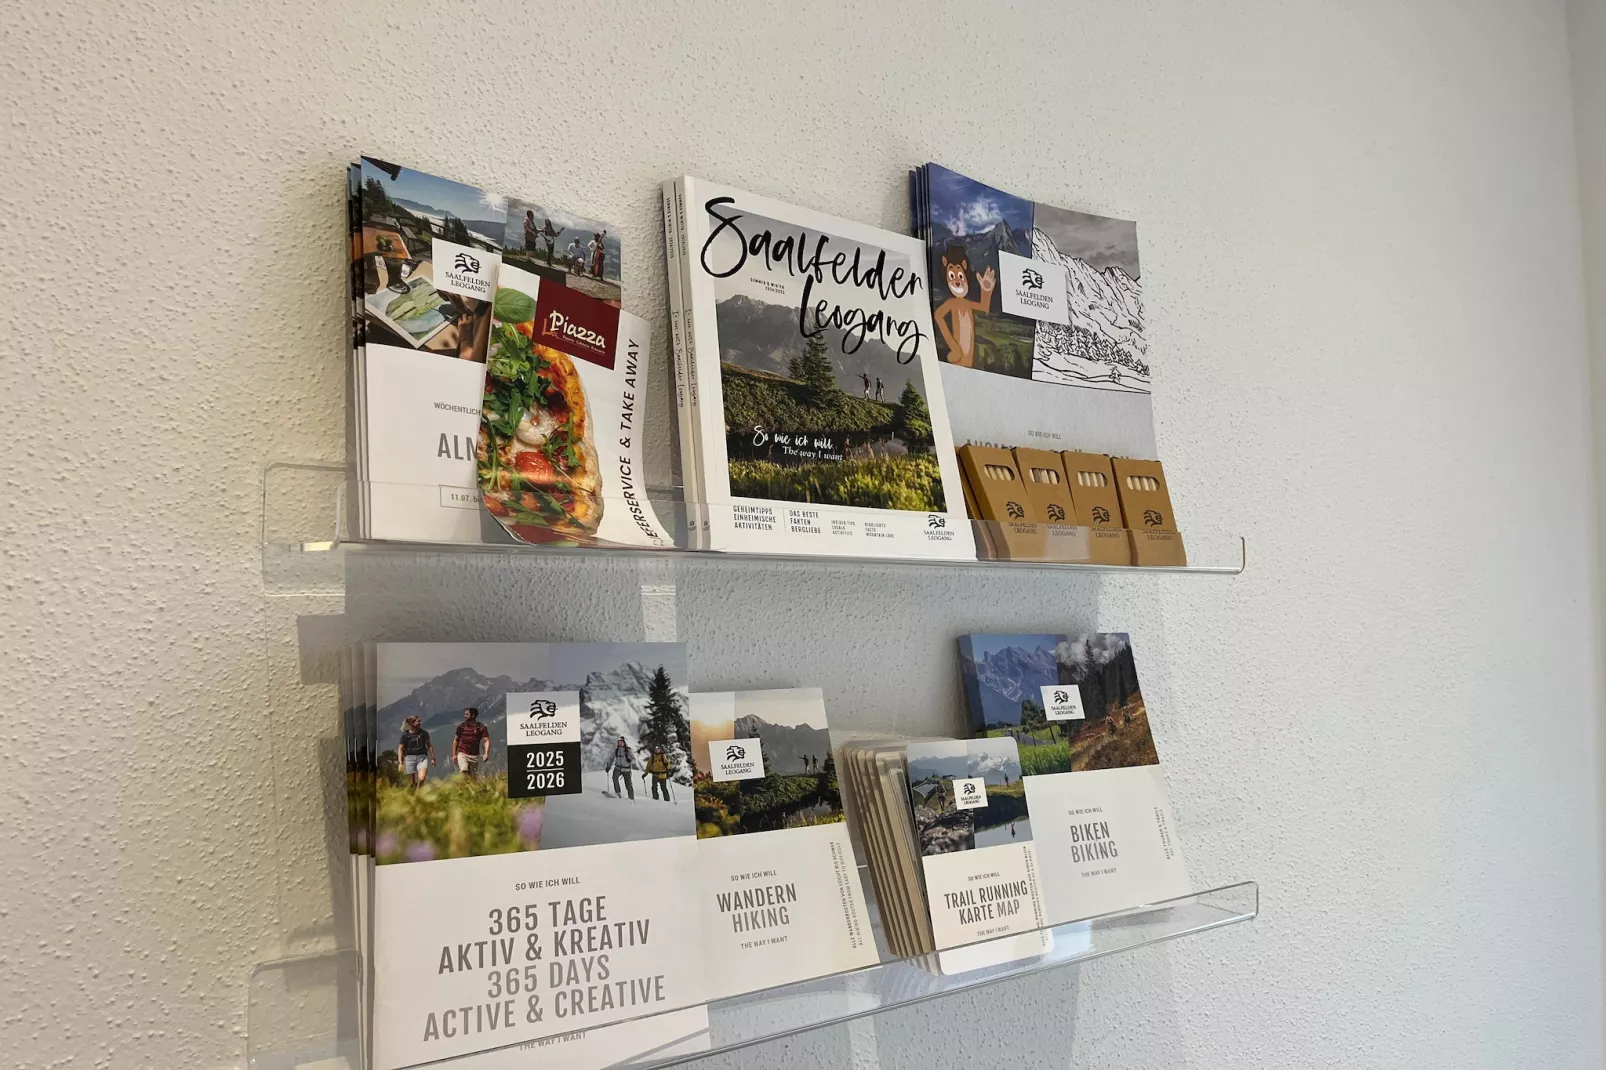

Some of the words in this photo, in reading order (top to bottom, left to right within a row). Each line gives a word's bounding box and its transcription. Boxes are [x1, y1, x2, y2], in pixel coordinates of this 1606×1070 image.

[700, 196, 924, 301] Saalfelden
[445, 271, 491, 288] SAALFELDEN
[450, 280, 486, 294] LEOGANG
[1015, 288, 1054, 303] SAALFELDEN
[1020, 296, 1050, 310] LEOGANG
[800, 274, 930, 366] Leogang
[550, 310, 606, 348] Piazza
[626, 338, 639, 389] AWAY
[620, 391, 635, 430] TAKE
[619, 435, 632, 448] &
[753, 426, 769, 446] So
[774, 433, 790, 445] wie
[795, 434, 809, 447] ich
[814, 438, 834, 450] will
[783, 446, 798, 456] The
[800, 450, 816, 460] way
[824, 452, 843, 461] want
[732, 505, 773, 515] GEHEIMTIPPS
[734, 513, 776, 523] EINHEIMISCHE
[734, 521, 772, 531] AKTIVITÄTEN
[791, 525, 821, 534] BERGLIEBE
[520, 721, 568, 730] SAALFELDEN
[526, 728, 563, 737] LEOGANG
[526, 751, 564, 768] 2025
[726, 767, 752, 775] LEOGANG
[526, 772, 565, 790] 2026
[1070, 821, 1110, 842] BIKEN
[1071, 840, 1118, 863] BIKING
[529, 881, 543, 889] WIE
[546, 879, 559, 887] ICH
[561, 877, 580, 886] WILL
[717, 883, 797, 912] WANDERN
[944, 889, 976, 909] TRAIL
[979, 880, 1028, 903] RUNNING
[489, 904, 538, 935] 365
[549, 895, 607, 927] TAGE
[732, 906, 790, 933] HIKING
[959, 904, 994, 925] KARTE
[997, 899, 1020, 917] MAP
[438, 937, 515, 974] AKTIV
[525, 933, 542, 961] &
[554, 919, 650, 956] KREATIV
[754, 939, 766, 947] WAY
[771, 936, 788, 944] WANT
[488, 964, 538, 998] 365
[549, 954, 610, 988] DAYS
[423, 1000, 516, 1041] ACTIVE
[526, 994, 543, 1023] &
[555, 975, 665, 1018] CREATIVE
[563, 1032, 586, 1042] WANT
